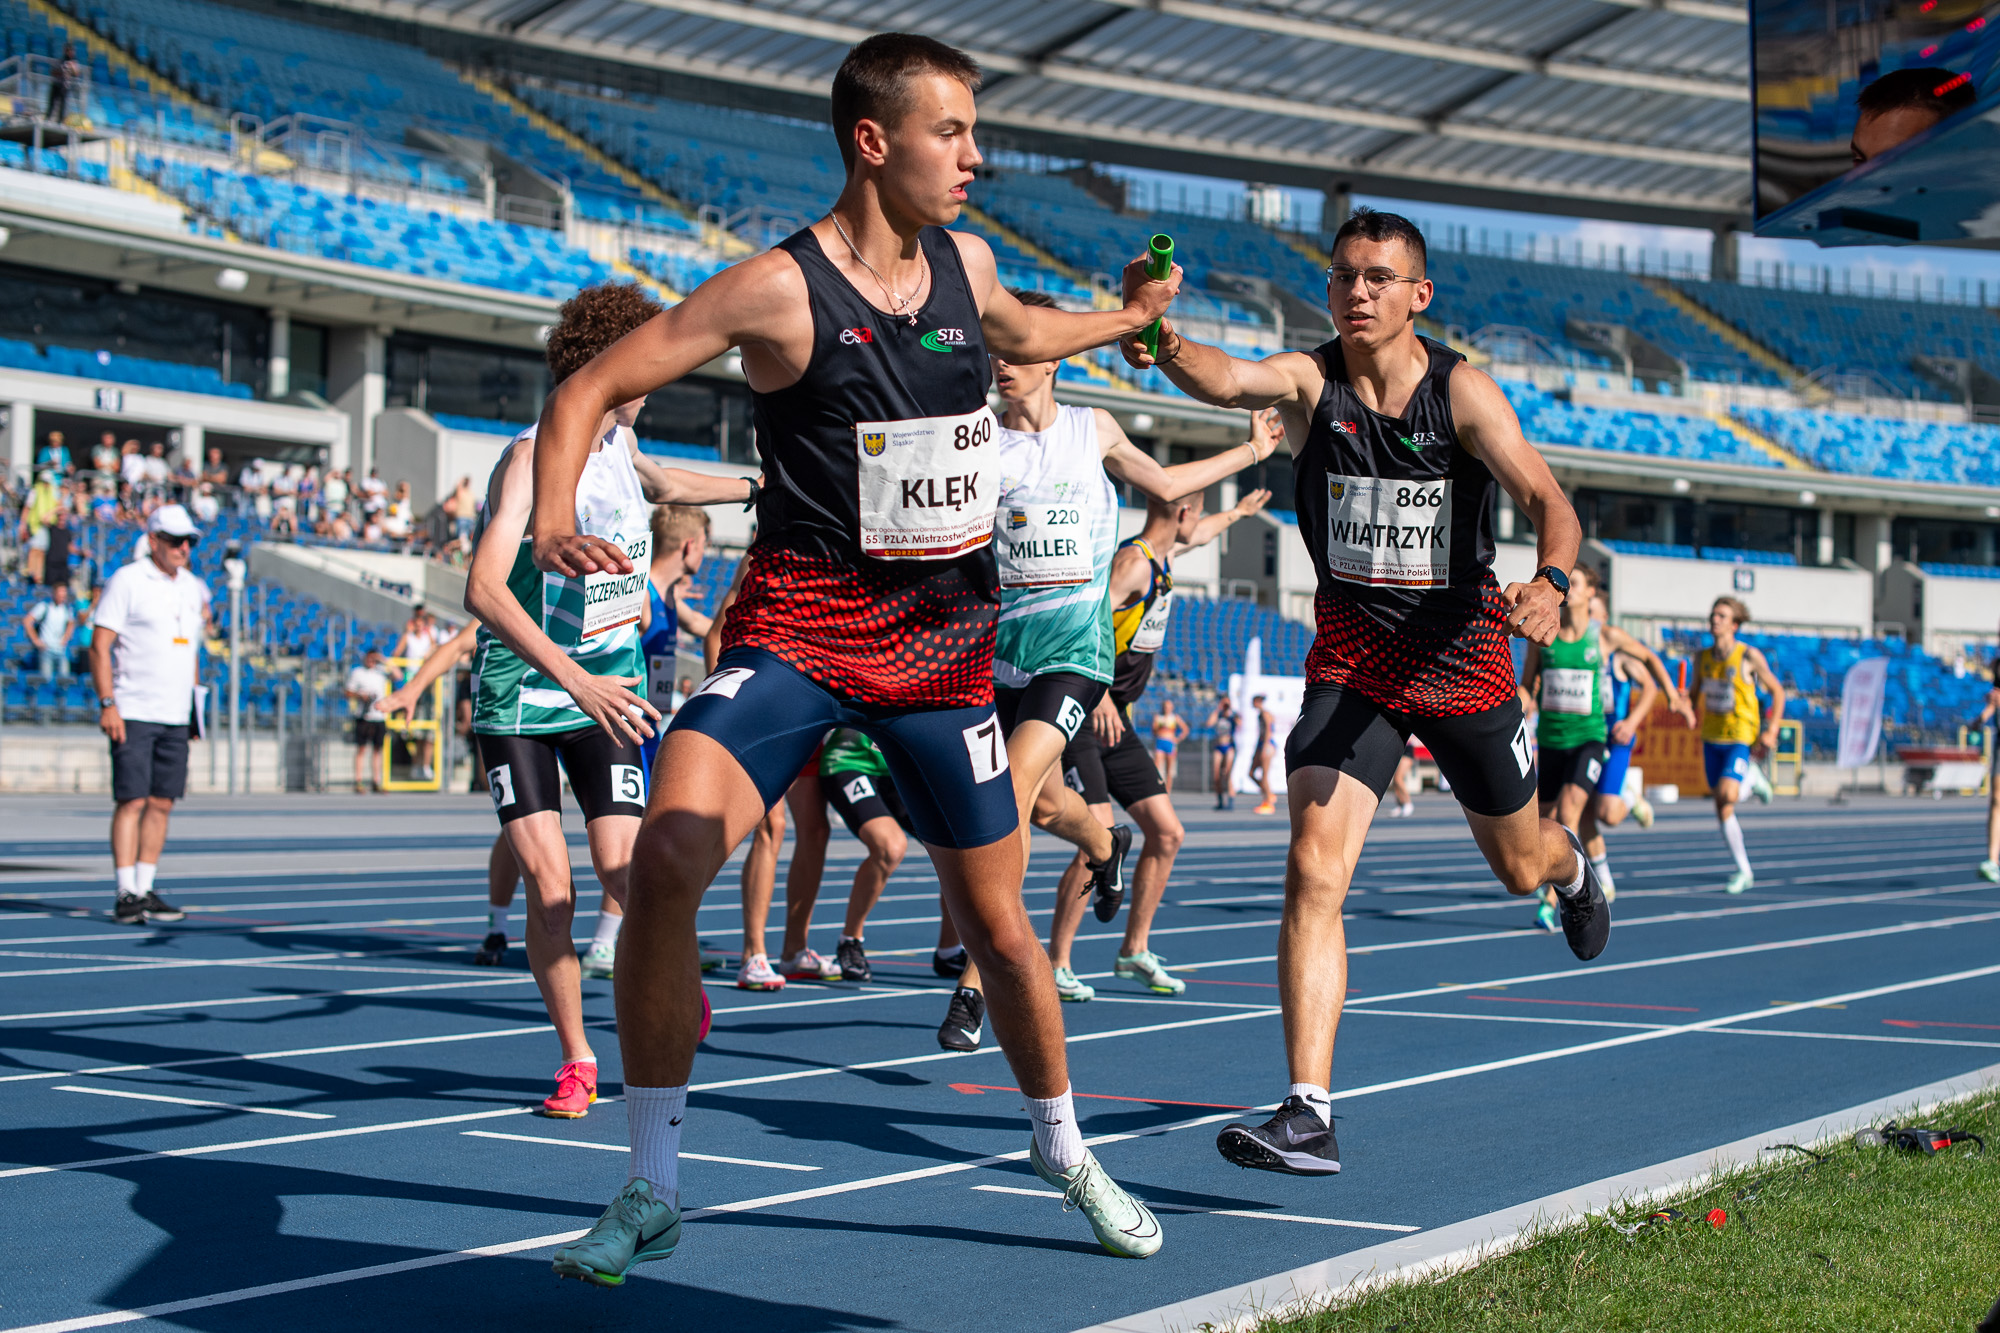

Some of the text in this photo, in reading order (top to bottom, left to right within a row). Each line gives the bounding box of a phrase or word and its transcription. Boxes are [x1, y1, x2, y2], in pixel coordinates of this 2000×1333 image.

[937, 328, 965, 341] STS
[892, 429, 935, 439] Województwo
[954, 416, 991, 450] 860
[1411, 431, 1436, 443] STS
[901, 471, 979, 512] KLĘK
[1396, 487, 1443, 508] 866
[1047, 510, 1080, 525] 220
[865, 534, 881, 545] 55.
[884, 534, 909, 544] PZLA
[1331, 517, 1446, 549] WIATRZYK
[627, 540, 646, 560] 223
[1009, 538, 1078, 560] MILLER
[1339, 561, 1357, 571] PZLA
[1358, 564, 1404, 577] Mistrzostwa
[1407, 569, 1430, 577] Polski
[1433, 568, 1447, 576] U18
[585, 573, 647, 606] SZCZEPAŃCZYK
[1065, 704, 1082, 731] 5
[977, 721, 998, 773] 7
[1515, 726, 1530, 765] 7
[491, 770, 505, 804] 5
[622, 768, 640, 799] 5
[853, 780, 866, 797] 4
